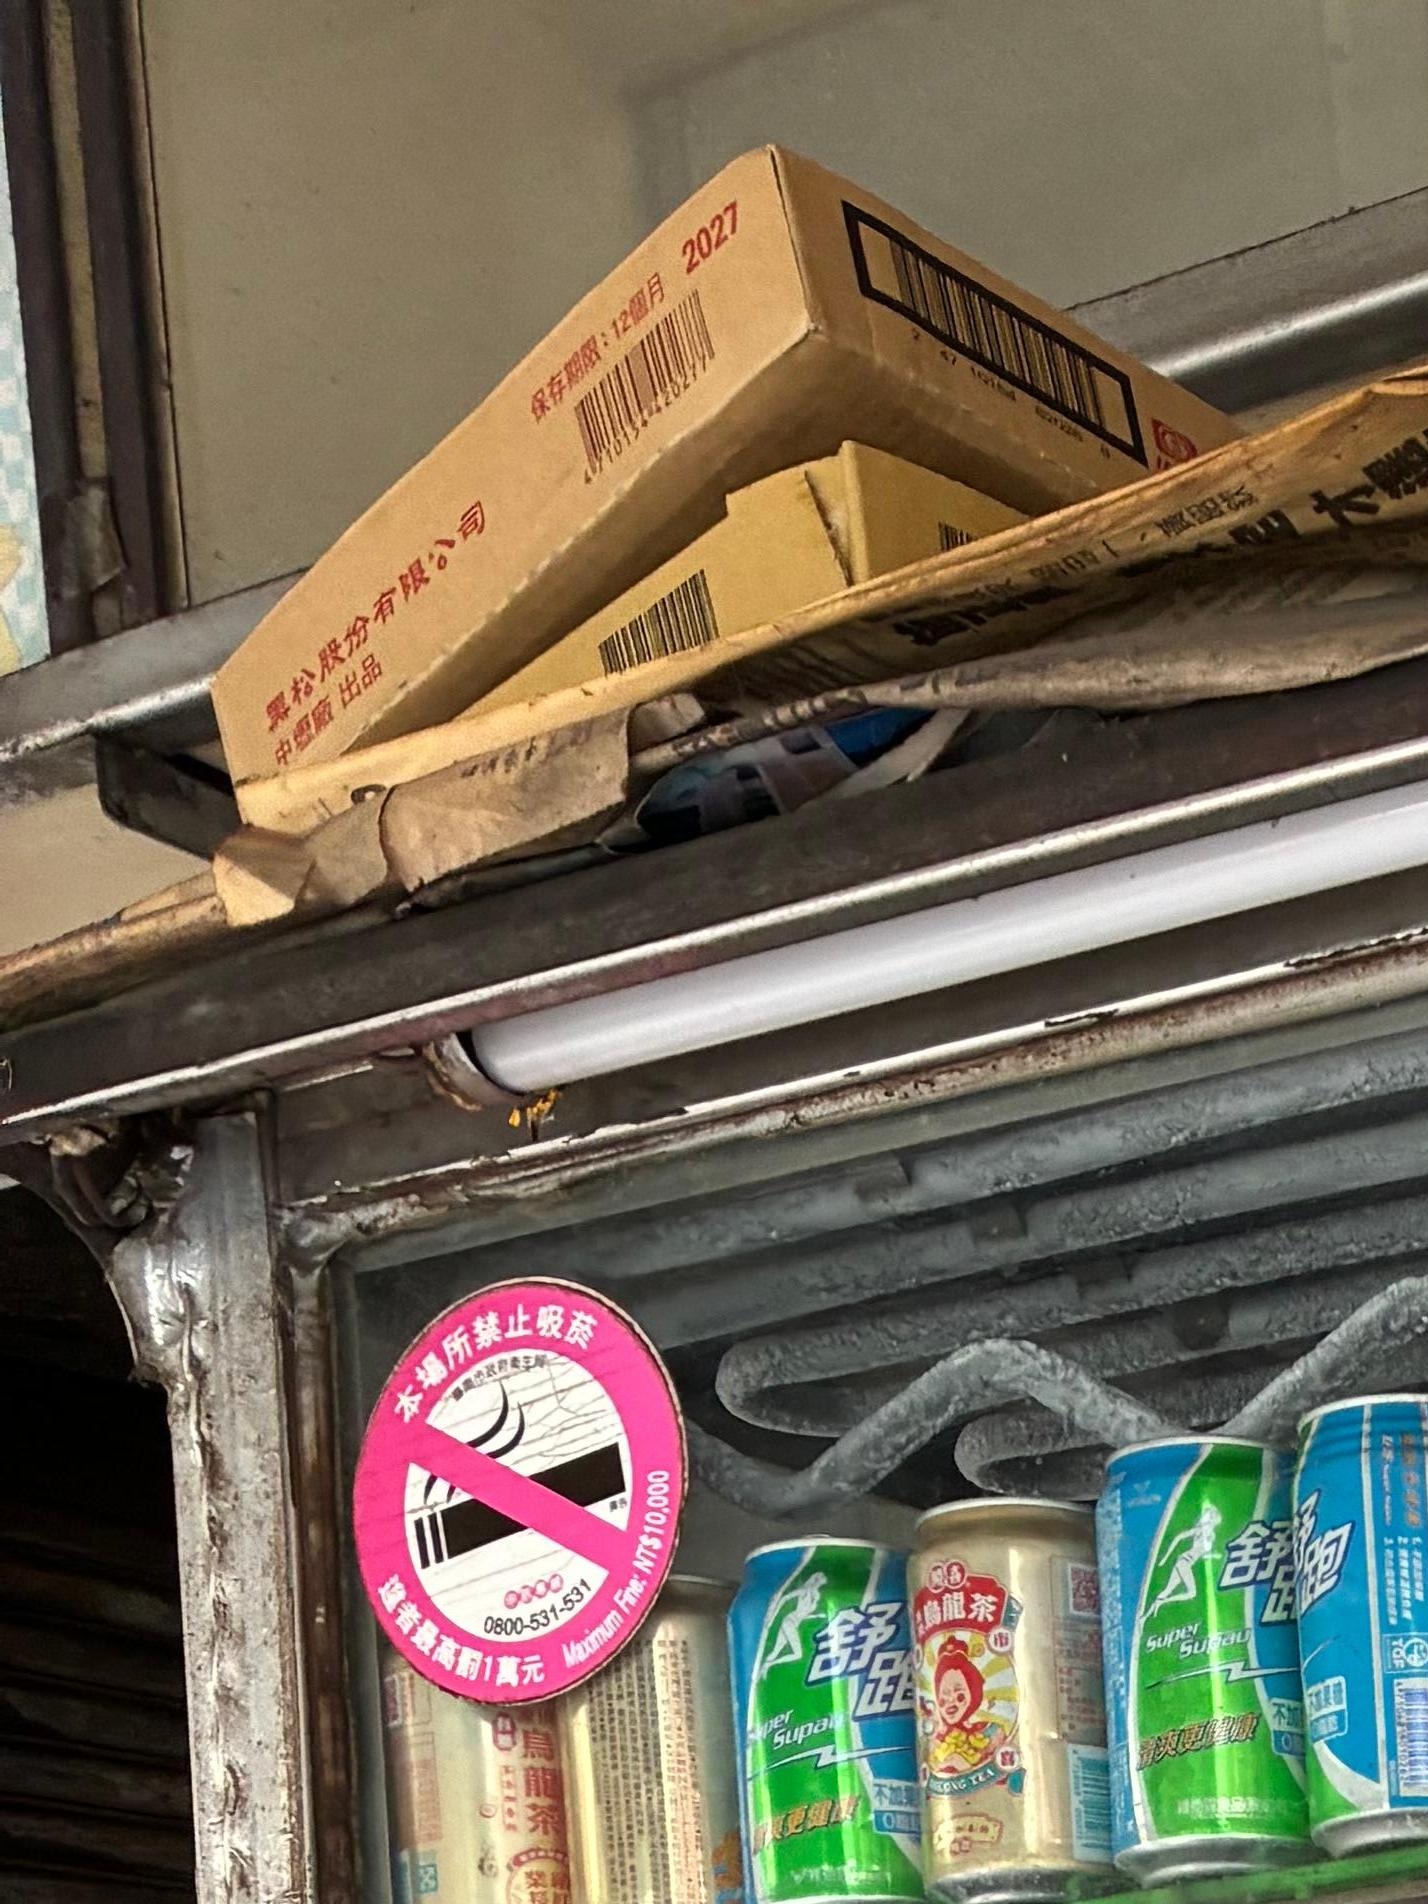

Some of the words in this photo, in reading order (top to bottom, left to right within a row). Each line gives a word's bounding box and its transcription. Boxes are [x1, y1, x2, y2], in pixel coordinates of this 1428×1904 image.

[682, 200, 738, 275] 2027
[265, 500, 486, 732] 黑松股份有限公司
[338, 653, 383, 709] 出品
[394, 1303, 597, 1424] 本場所禁止吸菸
[560, 1608, 625, 1668] Maximum
[613, 1573, 648, 1616] Fine:
[632, 1469, 671, 1576] NT$10,000
[484, 1578, 592, 1636] 0800-531-531
[1146, 1623, 1200, 1653] Super
[1178, 1627, 1254, 1660] Supau
